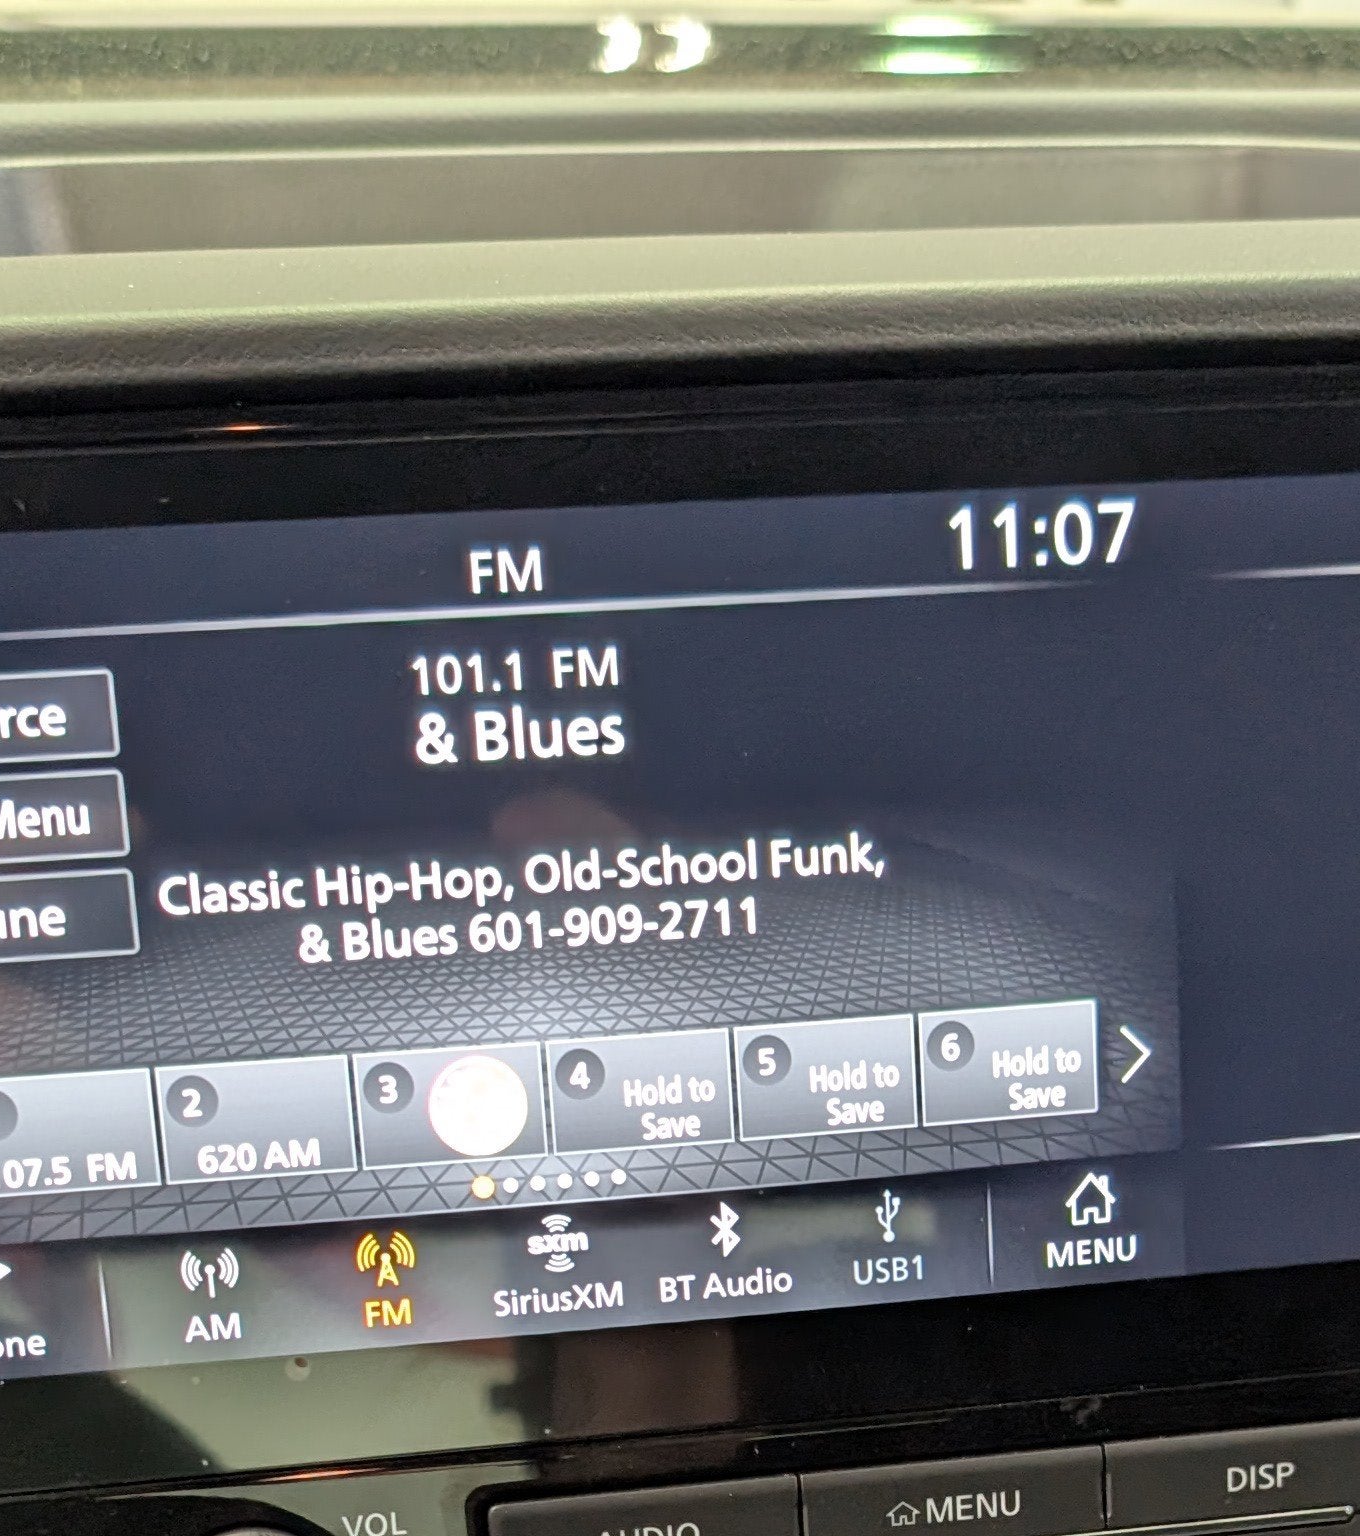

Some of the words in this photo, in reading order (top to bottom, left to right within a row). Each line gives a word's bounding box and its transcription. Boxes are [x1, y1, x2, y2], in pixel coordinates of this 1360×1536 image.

[948, 497, 1136, 570] 11:07
[469, 545, 543, 595] FM
[411, 649, 523, 696] 101.1
[552, 644, 619, 689] FM
[415, 711, 459, 765] &
[473, 703, 626, 762] Blues
[158, 869, 306, 916] Classic
[315, 861, 515, 914] Hip-Hop,
[524, 837, 758, 894] Old-School
[770, 830, 885, 879] Funk,
[298, 923, 333, 964] &
[342, 917, 459, 961] Blues
[468, 895, 757, 953] 601-909-2711
[758, 1047, 777, 1077] 5
[940, 1032, 961, 1062] 6
[991, 1044, 1050, 1079] Hold
[1053, 1047, 1082, 1074] to
[378, 1074, 399, 1105] 3
[569, 1061, 591, 1090] 4
[622, 1073, 683, 1108] Hold
[686, 1076, 716, 1103] to
[808, 1058, 868, 1093] Hold
[871, 1062, 900, 1088] to
[181, 1088, 203, 1118] 2
[826, 1096, 885, 1126] Save
[1008, 1082, 1067, 1111] Save
[640, 1111, 701, 1141] Save
[86, 1150, 138, 1183] FM
[197, 1142, 258, 1175] 620
[263, 1137, 322, 1170] AM
[1046, 1234, 1137, 1269] MENU
[659, 1274, 696, 1303] BT
[702, 1266, 793, 1300] Audio
[853, 1254, 923, 1286] USB1
[364, 1298, 412, 1328] FM
[493, 1280, 624, 1318] SiriusXM
[184, 1312, 242, 1343] AM
[1227, 1462, 1295, 1493] DISP
[926, 1489, 1021, 1524] MENU
